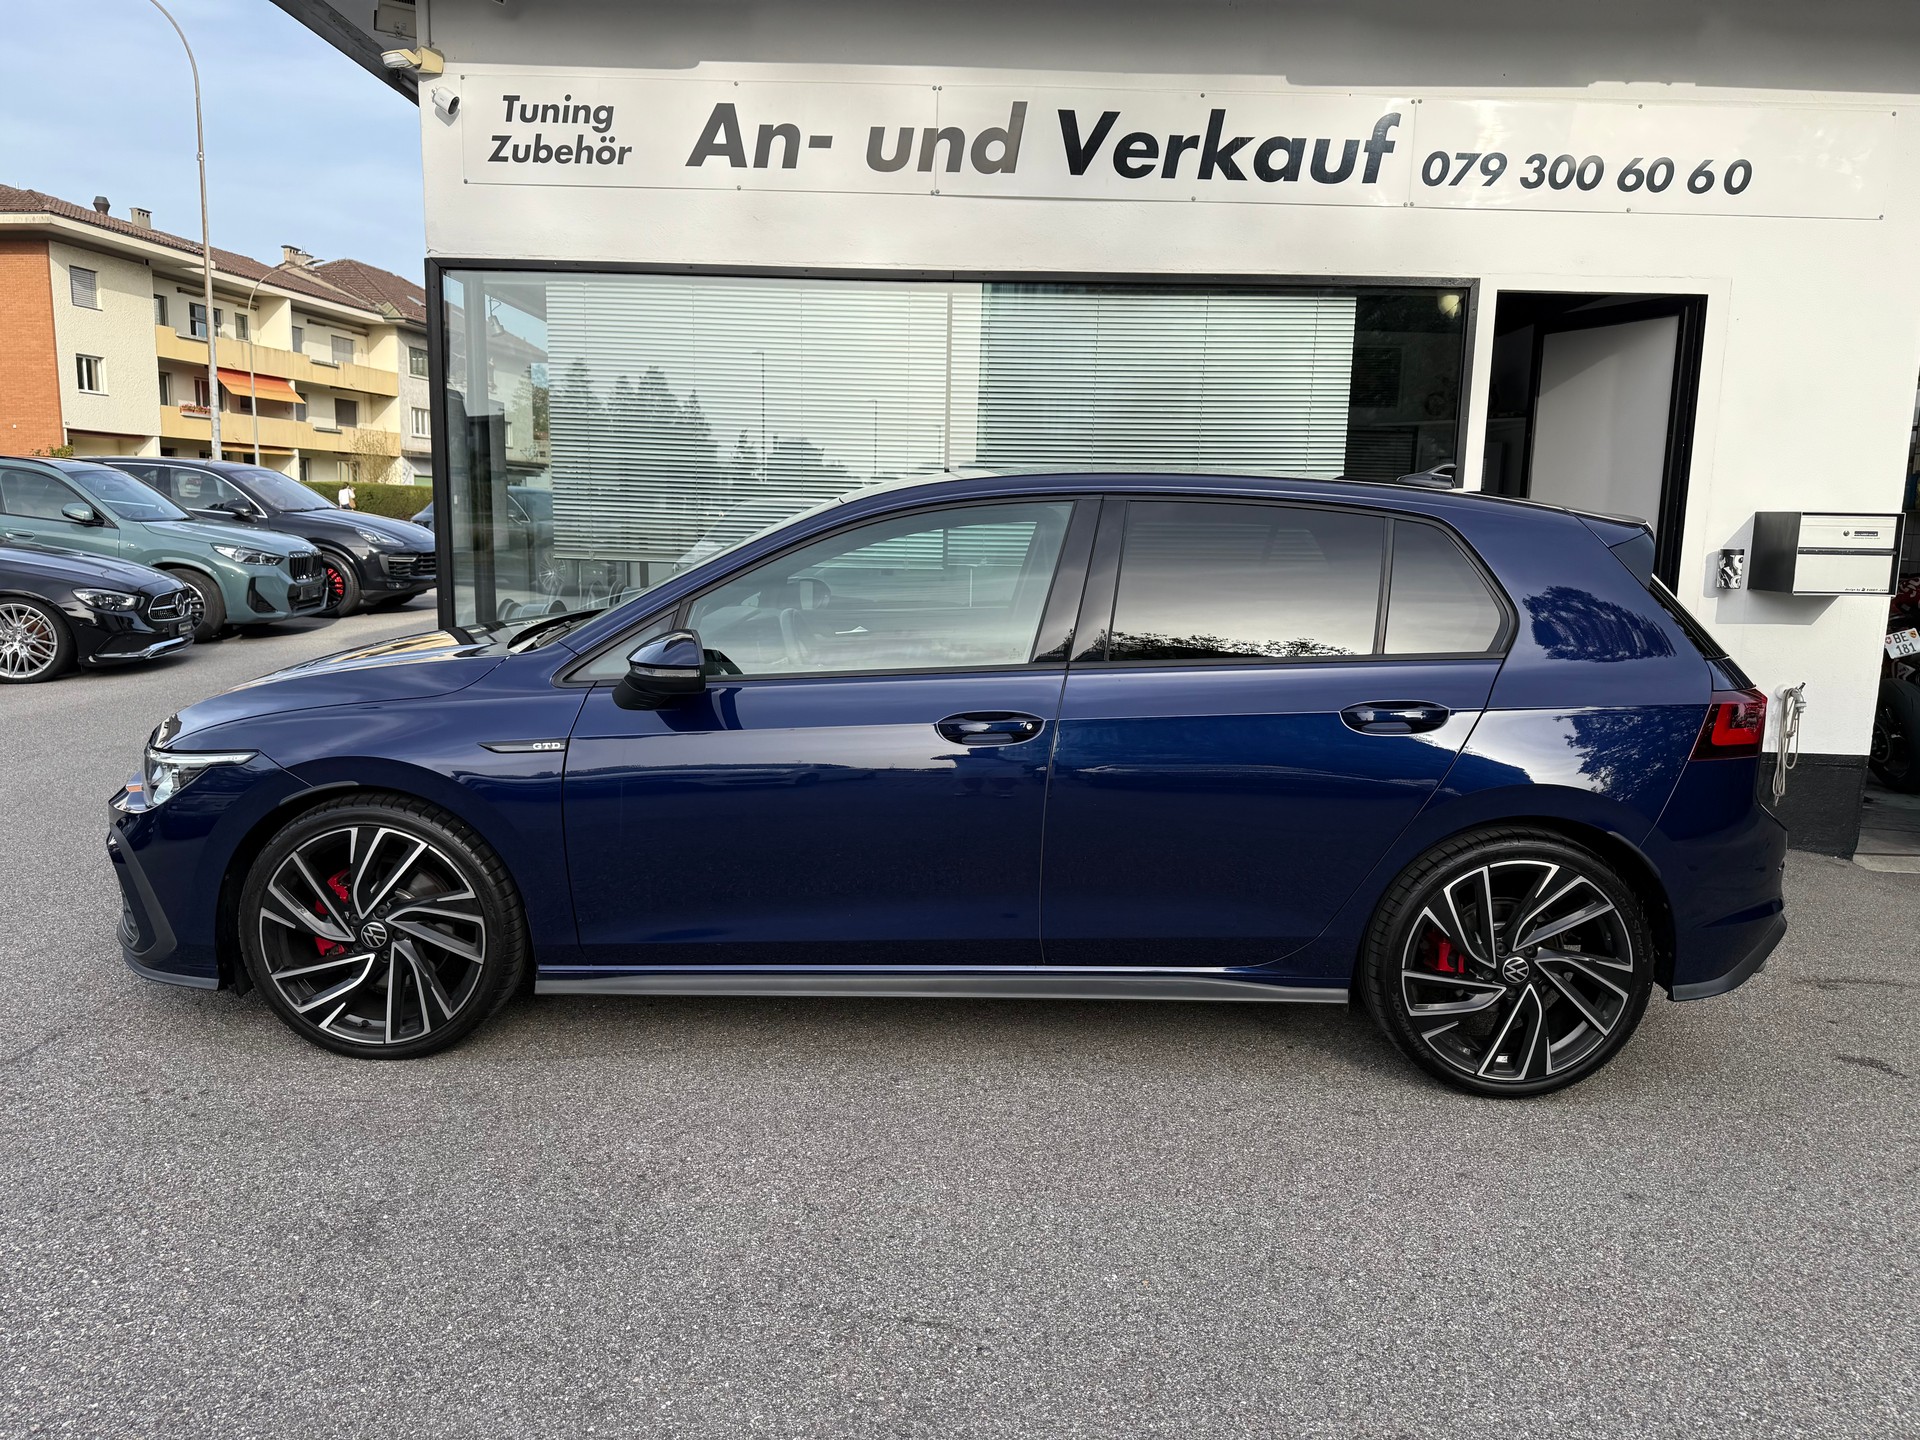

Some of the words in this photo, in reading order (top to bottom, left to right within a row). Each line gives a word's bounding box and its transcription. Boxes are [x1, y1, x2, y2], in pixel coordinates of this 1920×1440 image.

[502, 94, 615, 134] Tuning
[487, 133, 633, 165] Zubehör
[685, 102, 833, 169] An-
[866, 101, 1028, 175] und
[1057, 108, 1402, 185] Verkauf
[1421, 150, 1508, 187] 079
[1519, 153, 1605, 192] 300
[1616, 158, 1675, 193] 60
[1893, 632, 1909, 644] BE
[1896, 642, 1917, 656] 181
[532, 742, 561, 750] GTD
